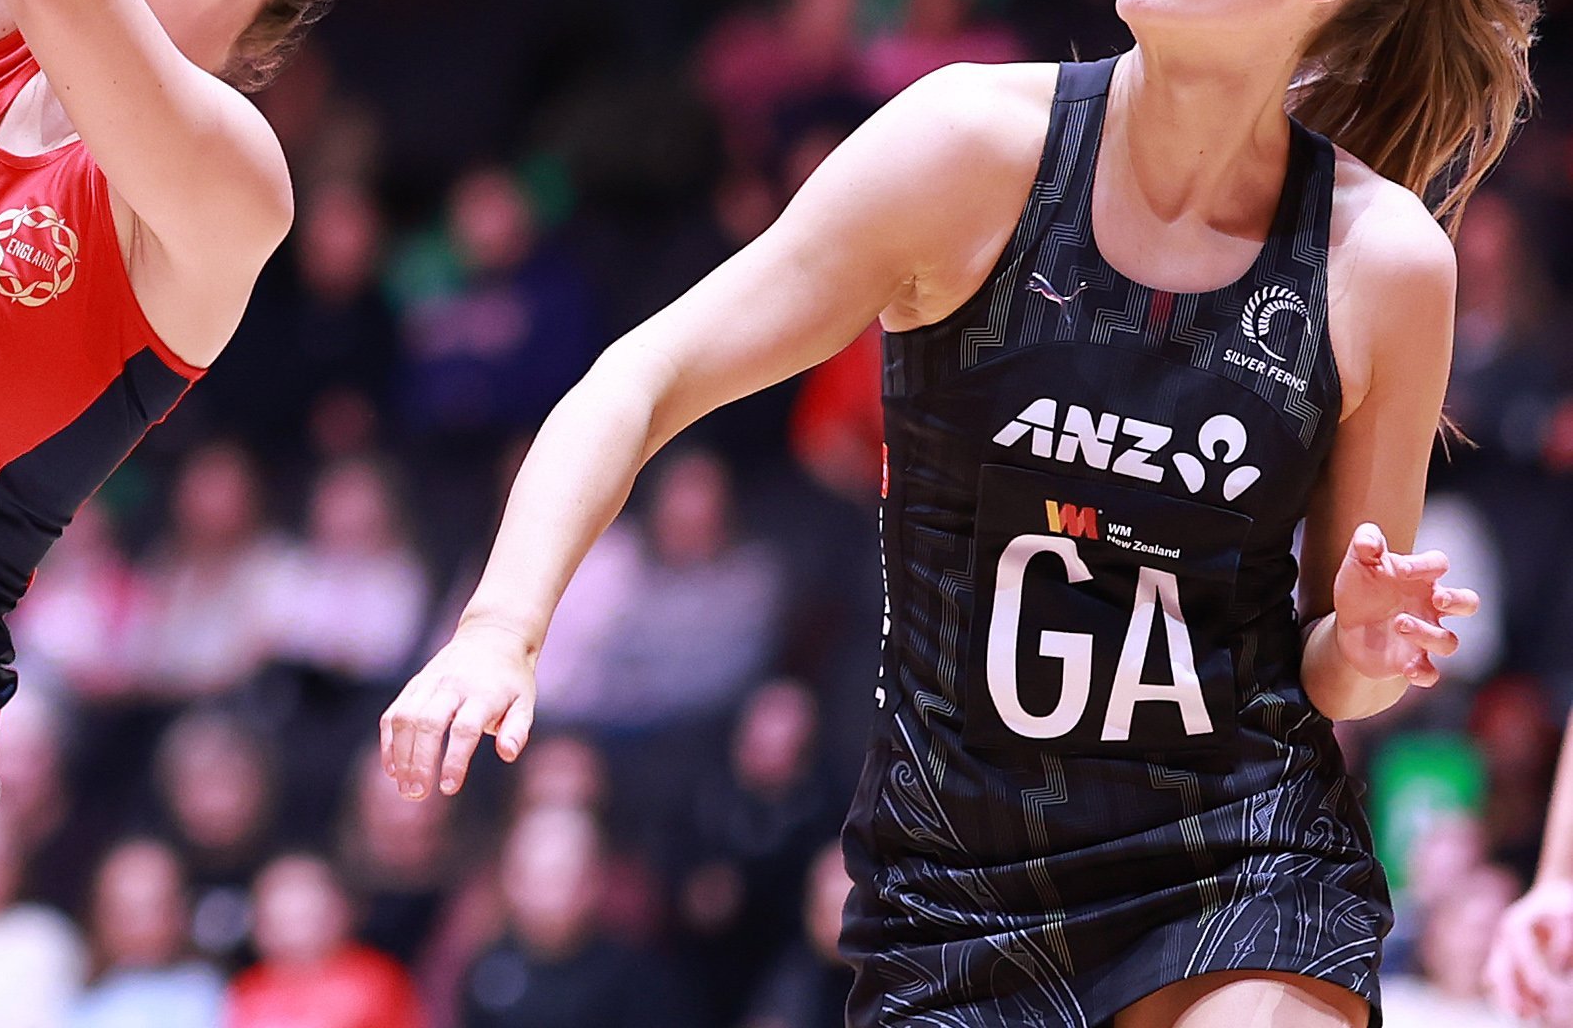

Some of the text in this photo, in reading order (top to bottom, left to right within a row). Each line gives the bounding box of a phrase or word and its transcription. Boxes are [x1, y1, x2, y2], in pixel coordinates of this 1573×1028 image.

[5, 237, 55, 272] ENGLAND
[1223, 349, 1307, 392] SILVER FERNS
[992, 397, 1173, 483] ANZ
[1107, 534, 1180, 559] New Zealand
[1108, 523, 1132, 537] WM
[987, 533, 1213, 741] GA
